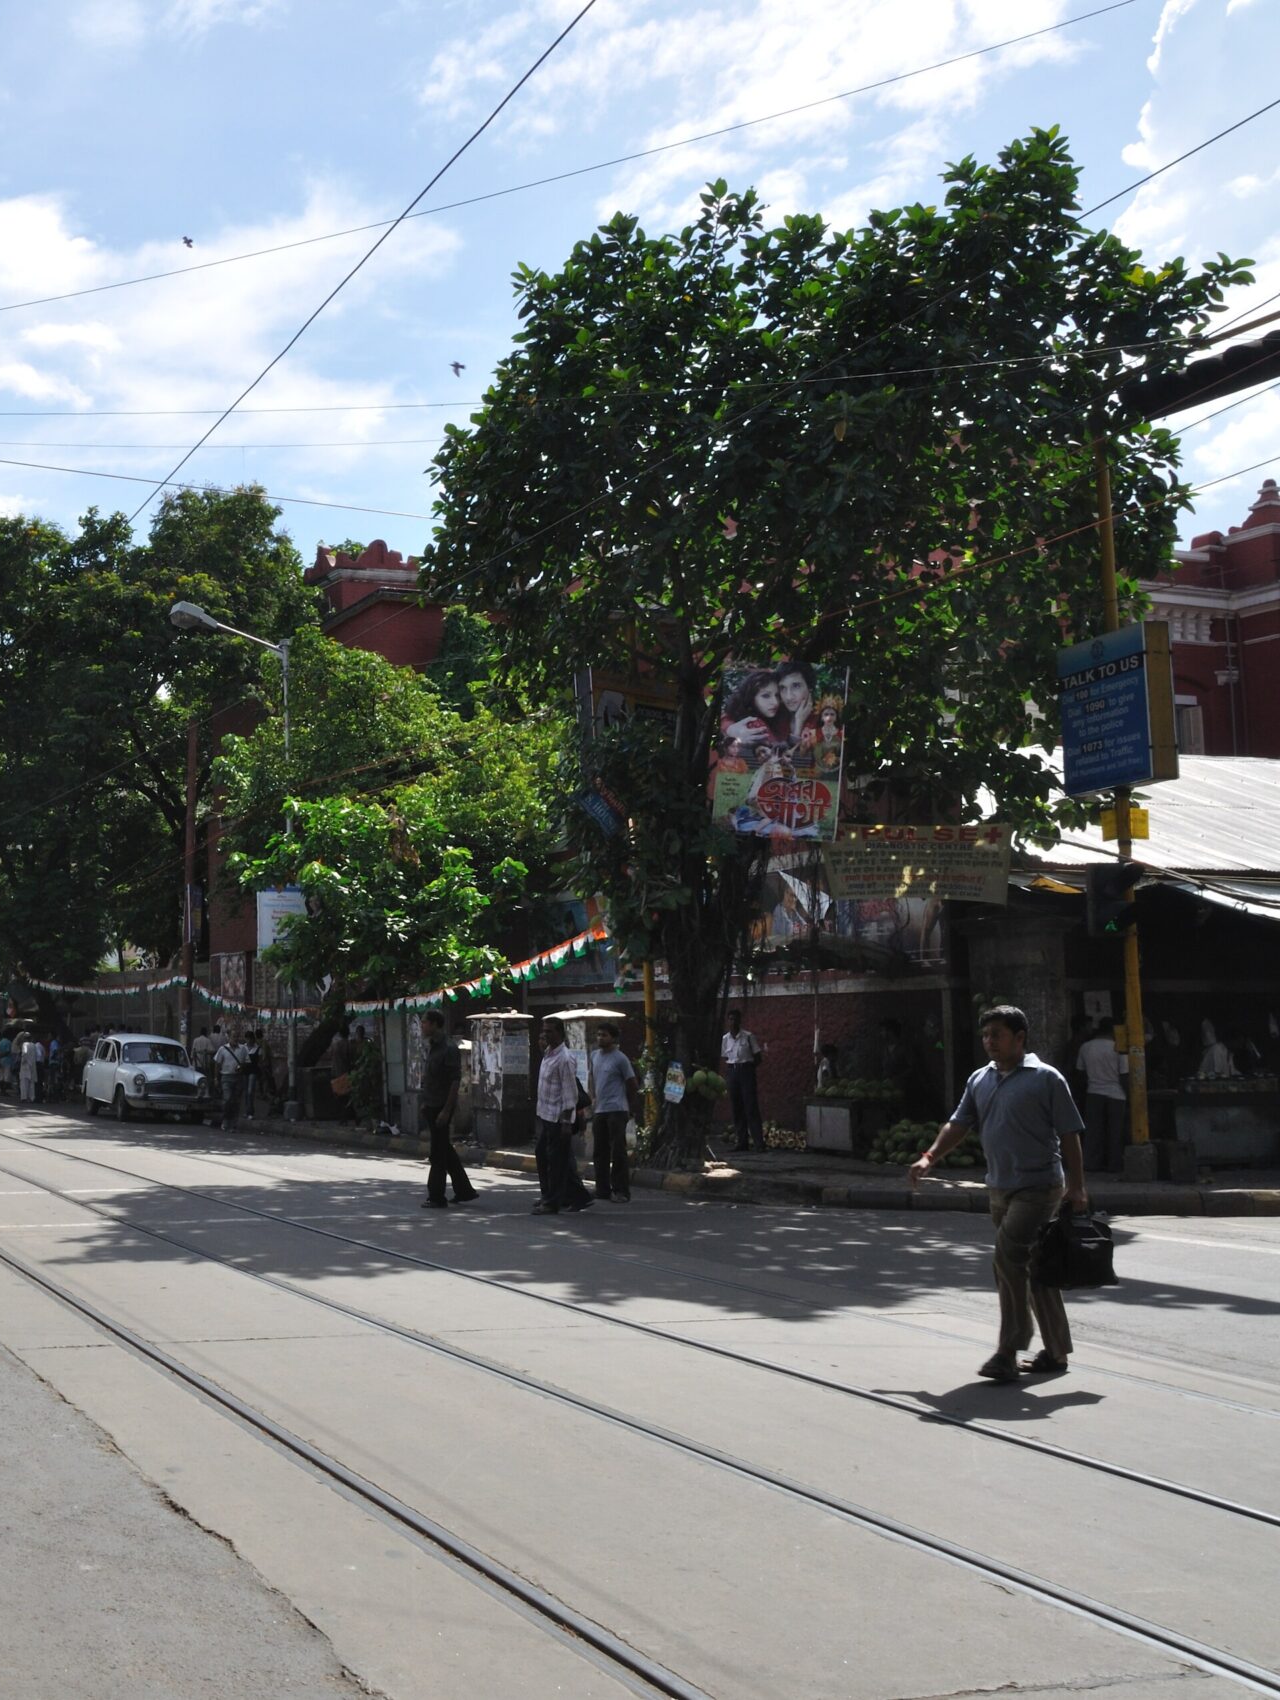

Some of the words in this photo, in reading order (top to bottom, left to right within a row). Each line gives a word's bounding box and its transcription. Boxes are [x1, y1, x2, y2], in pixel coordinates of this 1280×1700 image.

[1062, 671, 1096, 690] TALK
[1099, 664, 1117, 681] TO
[1119, 655, 1141, 671] US
[1076, 689, 1089, 700] 100
[1090, 686, 1100, 696] for
[1101, 677, 1139, 693] Emergency
[1085, 700, 1105, 712] 1090
[1108, 698, 1117, 707] to
[1118, 693, 1135, 706] give
[1072, 718, 1085, 729] any
[1086, 706, 1129, 722] information
[1079, 728, 1087, 737] to
[1088, 725, 1100, 735] the
[1101, 719, 1124, 732] police
[1104, 736, 1115, 746] for
[1116, 732, 1141, 744] issues
[1075, 755, 1100, 767] related
[1100, 751, 1110, 761] to
[1111, 746, 1135, 757] Traffic
[861, 826, 979, 843] PULSE
[865, 842, 928, 851] DIAGNOSTIC
[928, 842, 974, 851] CENTRE
